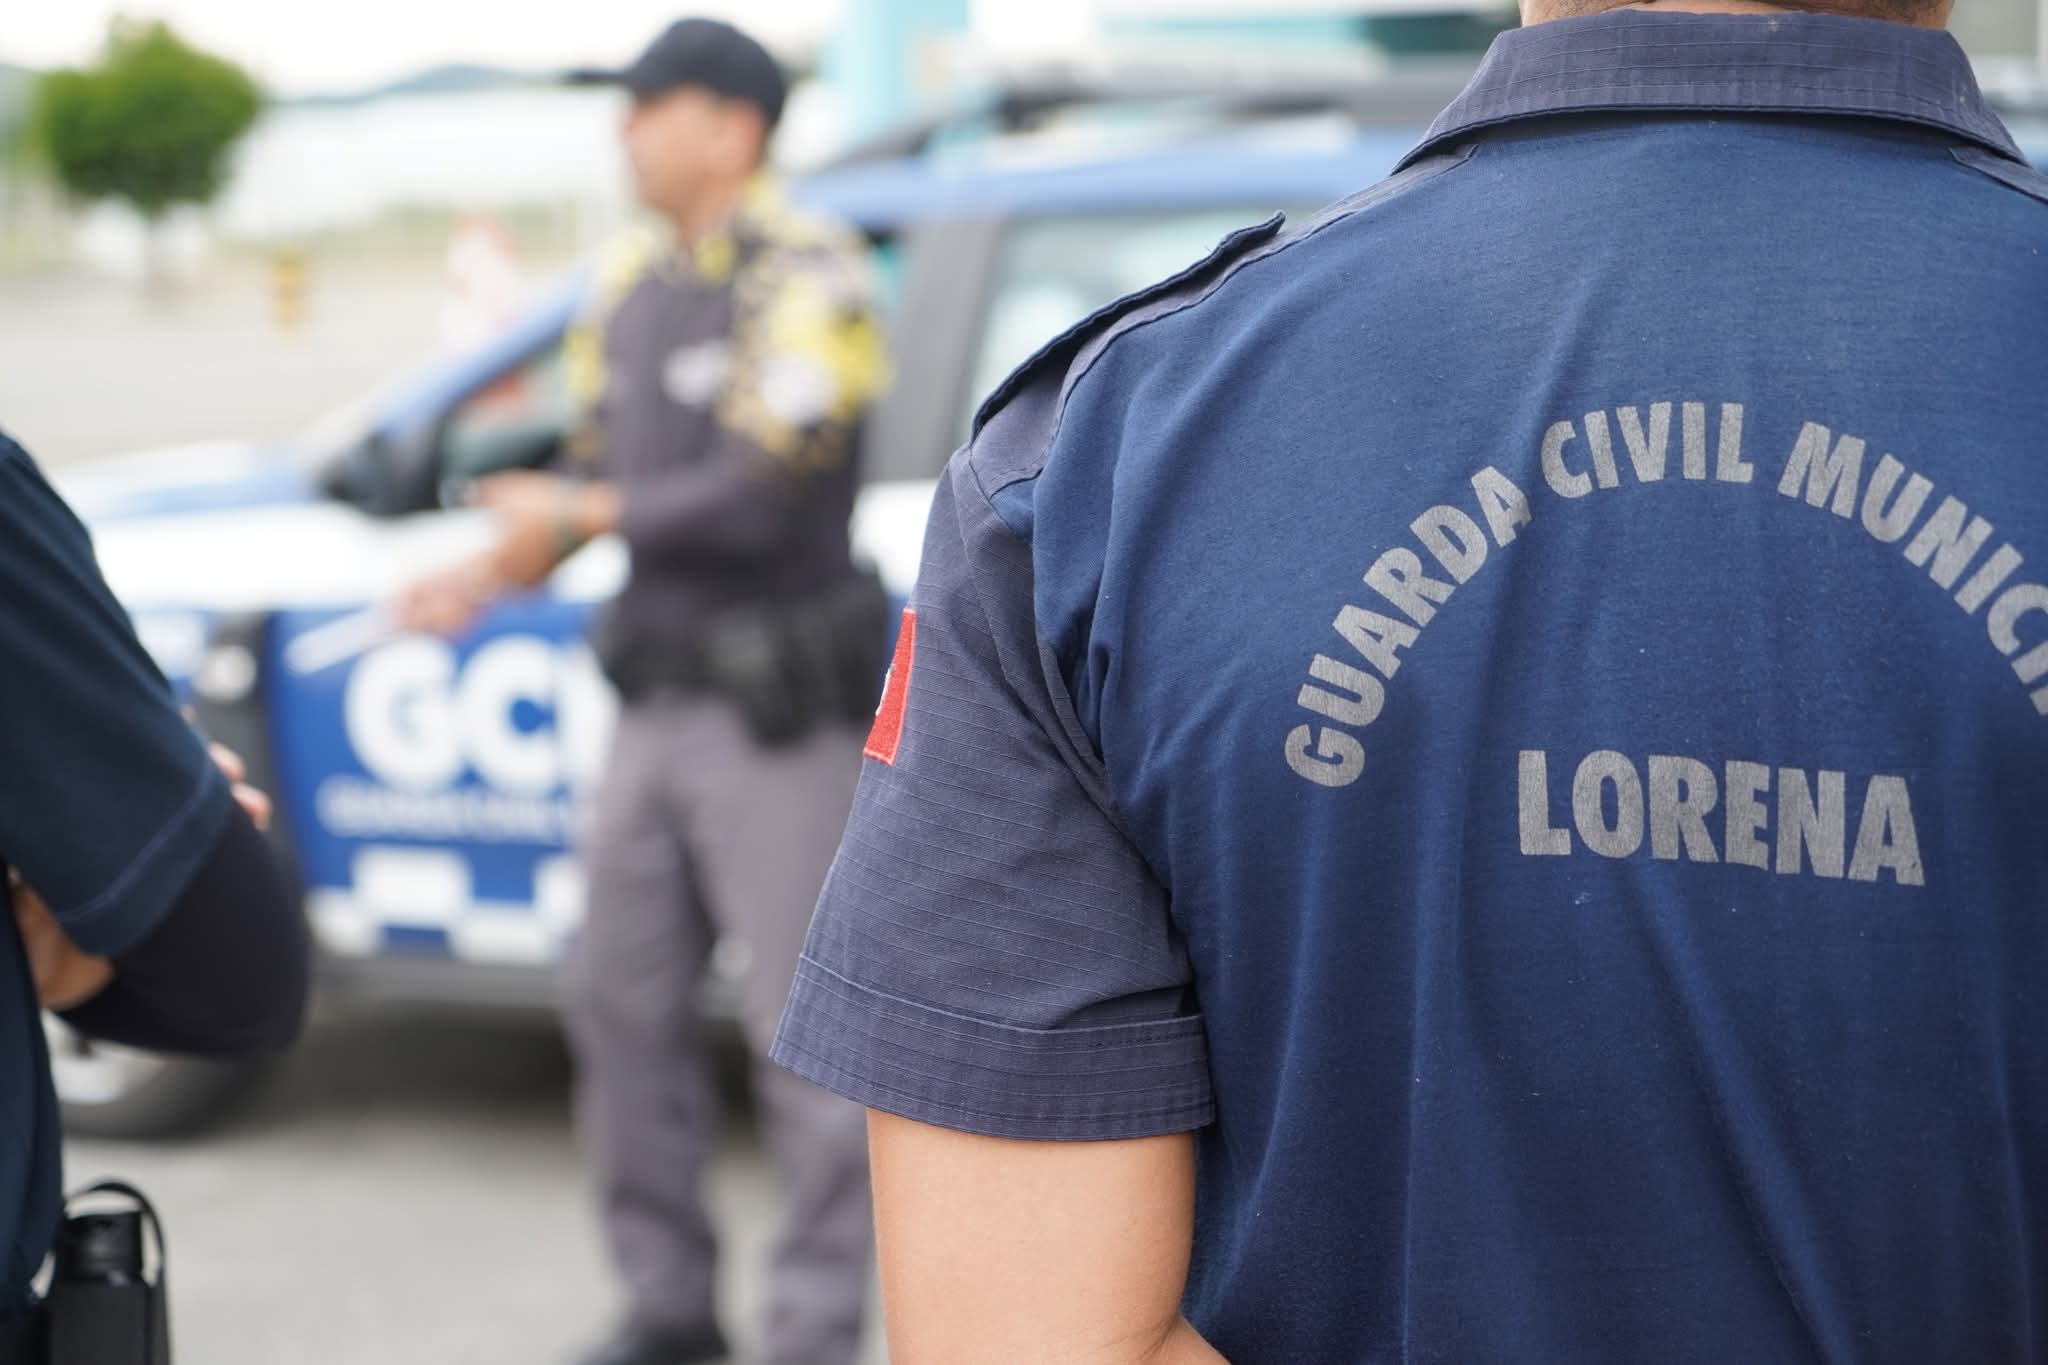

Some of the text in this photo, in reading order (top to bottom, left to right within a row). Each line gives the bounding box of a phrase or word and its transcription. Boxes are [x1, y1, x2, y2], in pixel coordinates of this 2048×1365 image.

[1283, 399, 2048, 788] GUARDA CIVIL MUNIC
[1517, 748, 1925, 887] LORENA
